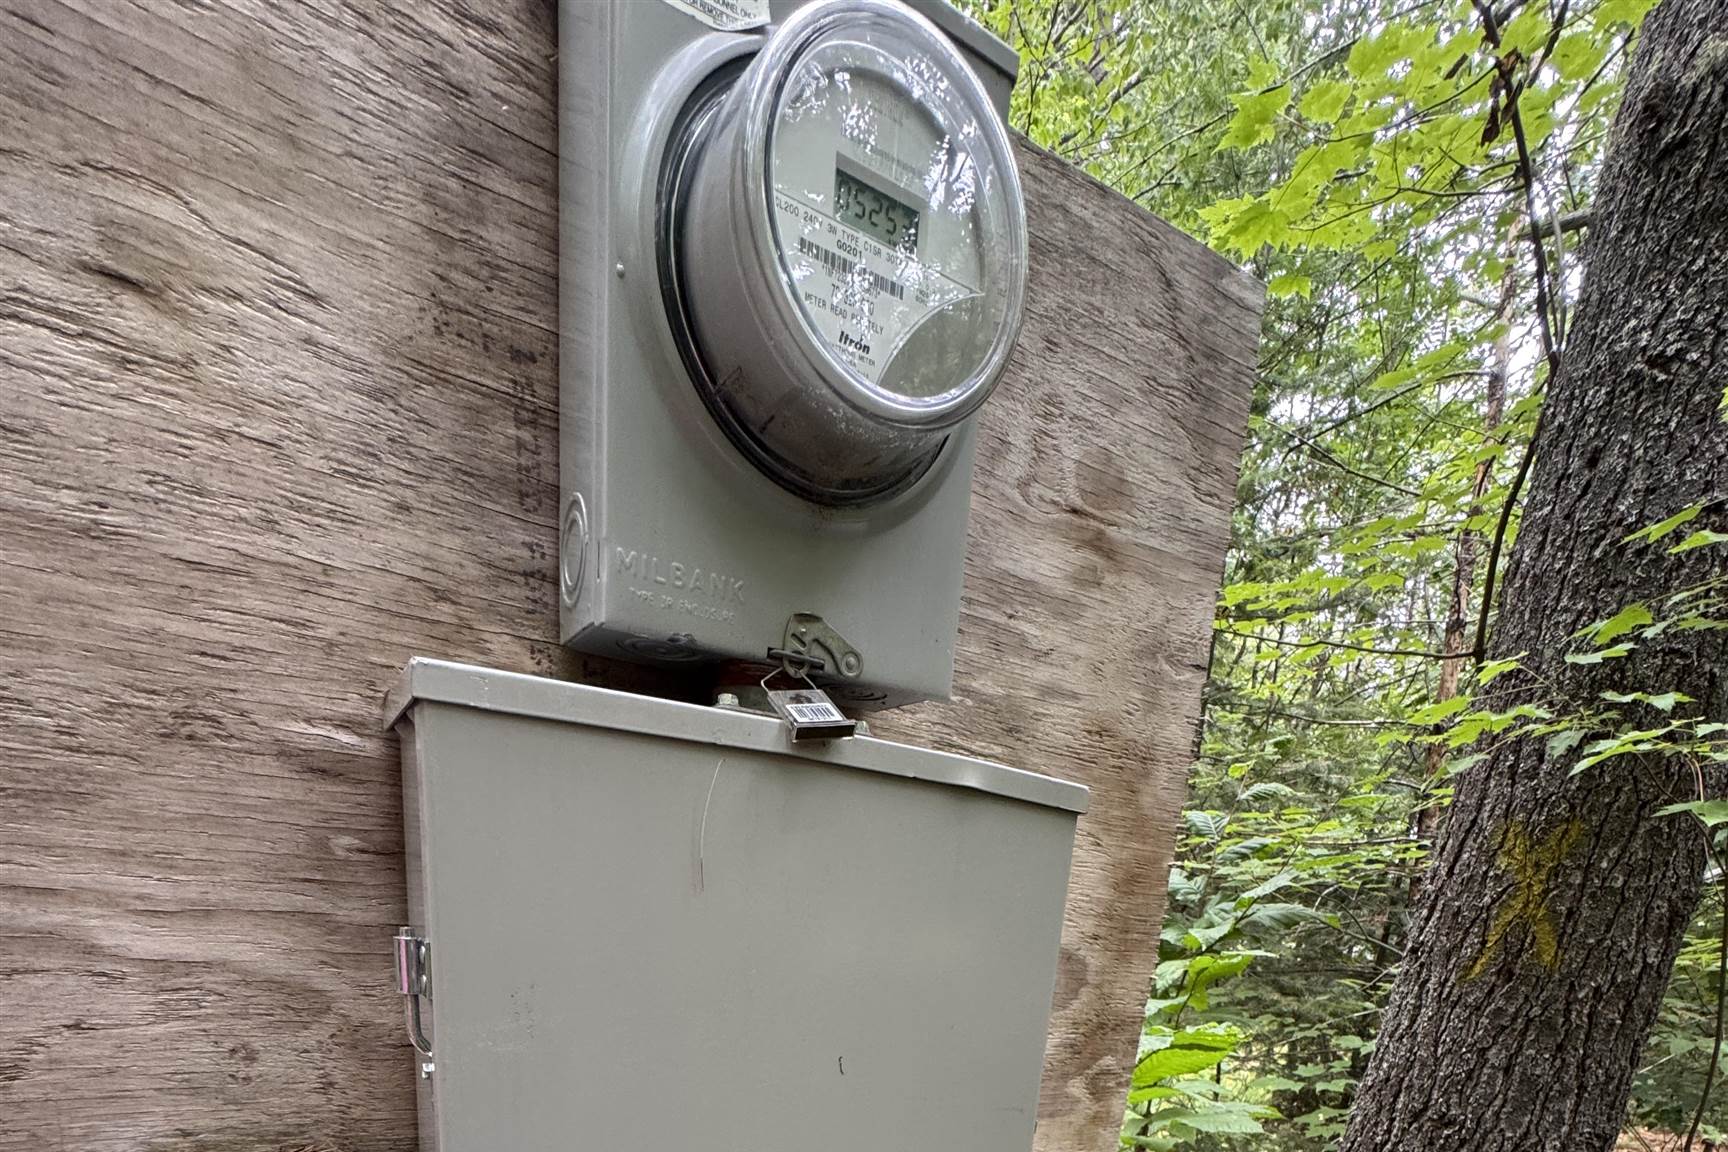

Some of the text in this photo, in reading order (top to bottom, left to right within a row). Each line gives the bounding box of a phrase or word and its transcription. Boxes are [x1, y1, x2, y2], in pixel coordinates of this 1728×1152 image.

[827, 224, 838, 236] 3W
[842, 229, 860, 247] TYPE
[804, 291, 826, 310] METER
[830, 303, 847, 319] READ
[838, 330, 870, 354] Itron
[616, 547, 744, 602] MILBANK
